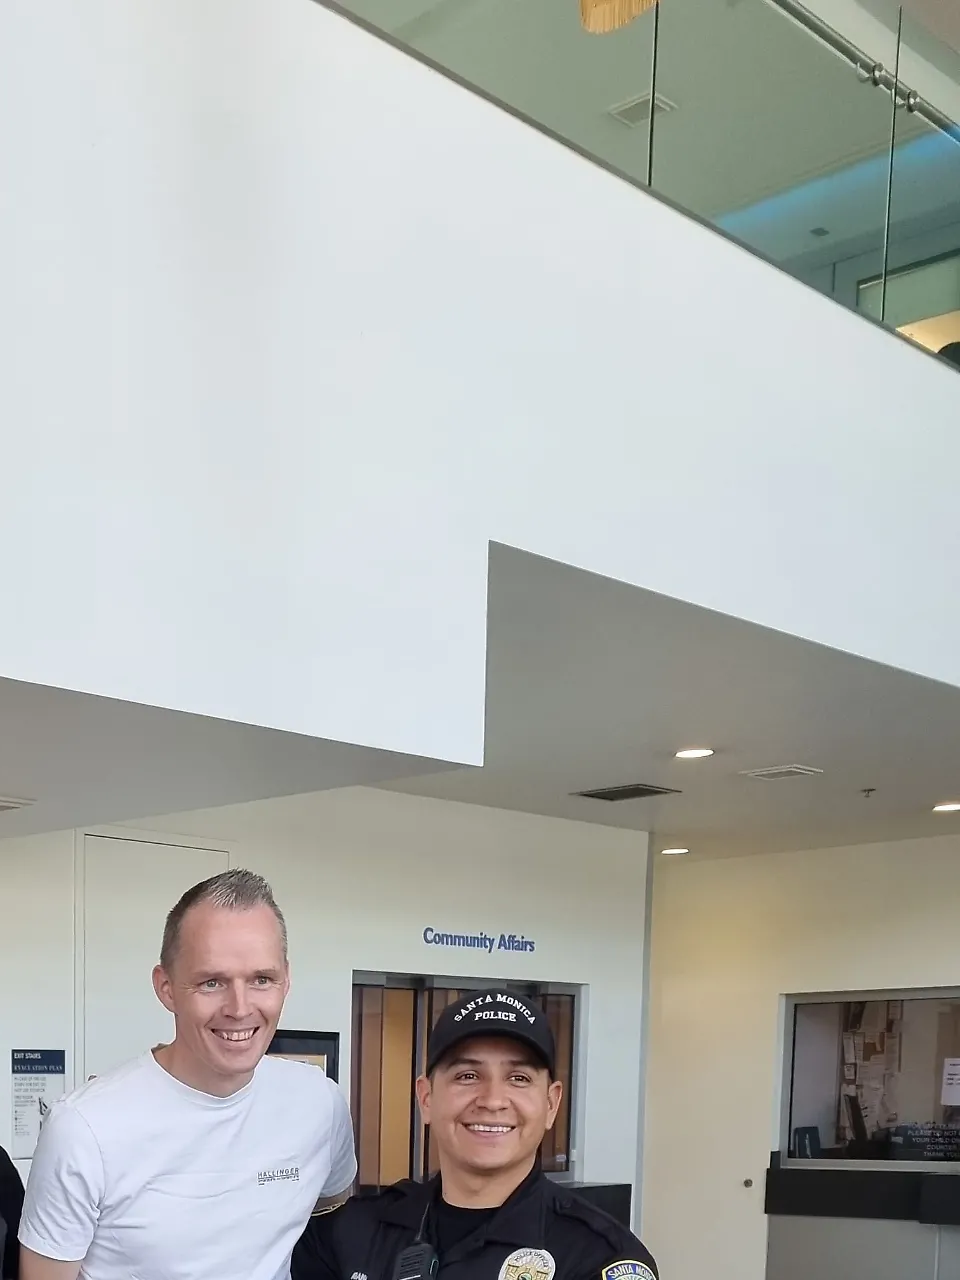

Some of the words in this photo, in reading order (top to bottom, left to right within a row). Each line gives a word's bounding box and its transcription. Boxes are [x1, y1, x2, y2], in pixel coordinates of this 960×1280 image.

[423, 927, 495, 953] Community
[497, 934, 536, 952] Affairs
[453, 994, 494, 1022] SANTA
[496, 993, 536, 1025] MONICA
[474, 1010, 517, 1023] POLICE
[608, 1264, 634, 1279] SANTA
